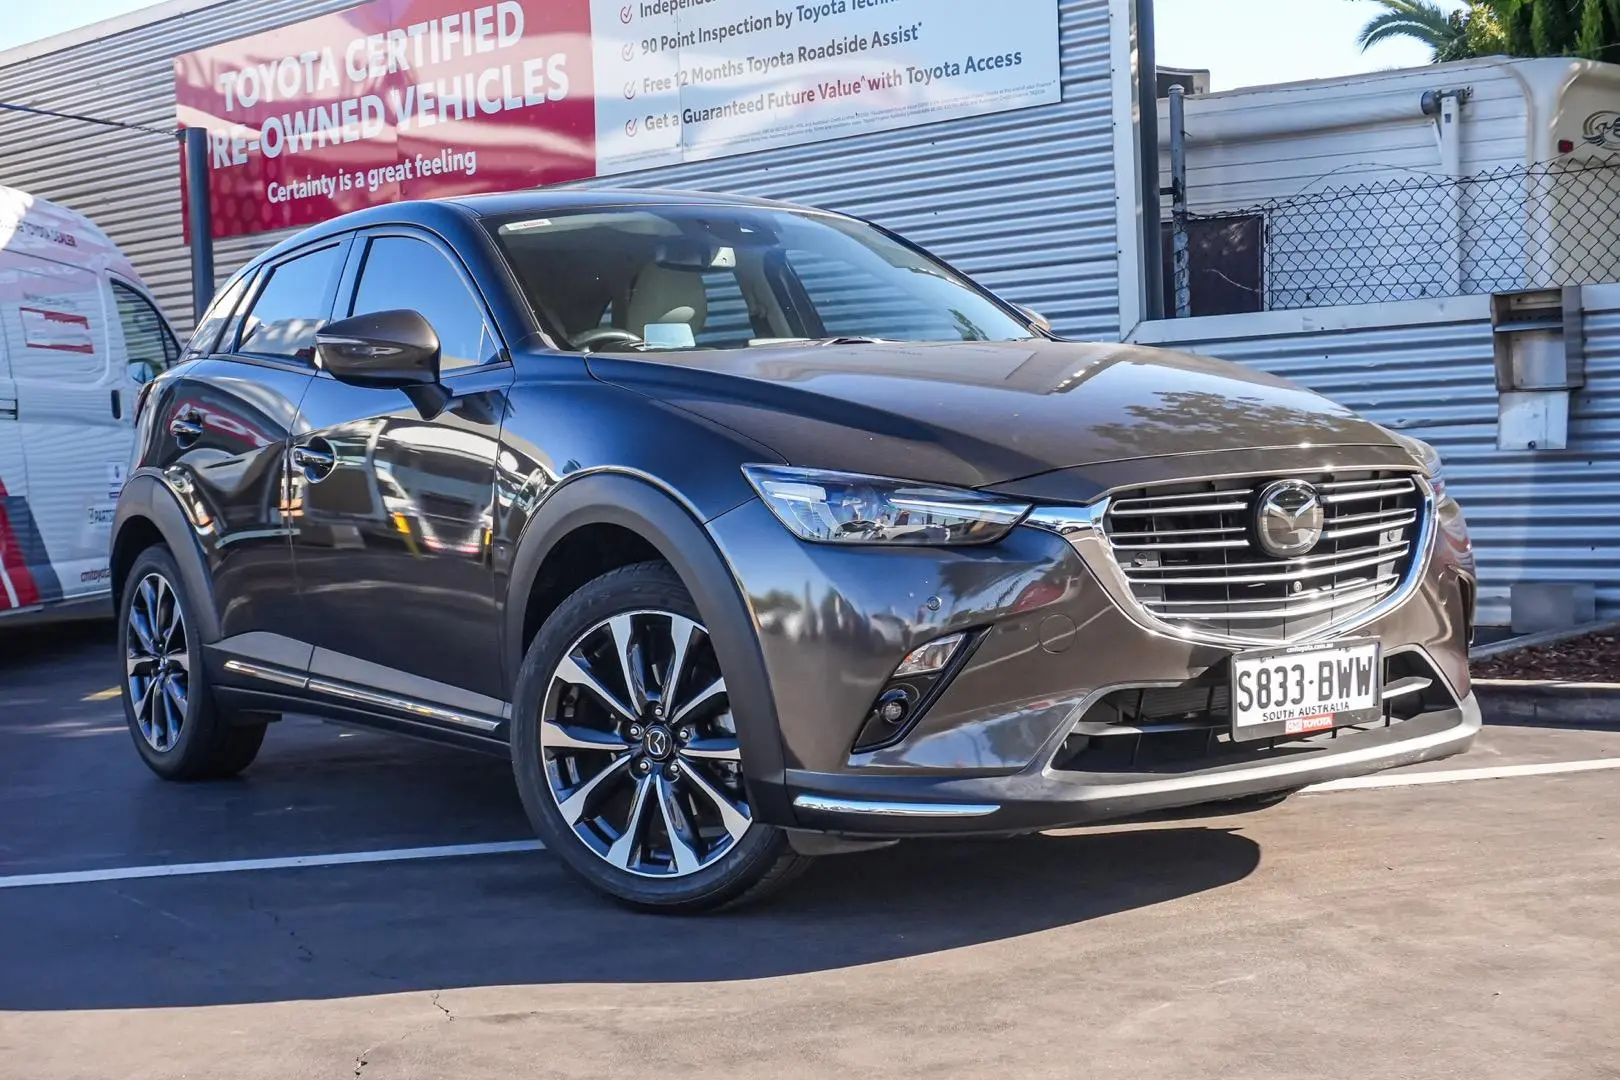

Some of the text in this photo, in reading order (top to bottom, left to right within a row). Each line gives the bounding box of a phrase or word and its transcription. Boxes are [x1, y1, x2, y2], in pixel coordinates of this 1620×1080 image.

[640, 0, 716, 18] Indepen
[641, 0, 899, 56] 90 Point Inspection by Toyota Tec
[219, 0, 525, 112] TOYOTA CERTIFIED
[643, 75, 672, 94] Free
[674, 71, 689, 88] 12
[691, 60, 745, 85] Months
[746, 51, 795, 75] Toyota
[797, 34, 868, 62] Roadside
[208, 53, 570, 170] RE-OWNED VEHICLES
[644, 111, 670, 132] Get
[671, 113, 680, 127] a
[682, 94, 765, 125] Guaranteed
[767, 88, 816, 110] Future
[867, 69, 903, 91] with
[905, 61, 961, 86] Toyota
[963, 50, 1023, 75] Access
[267, 147, 477, 204] Certainty is a great feeling
[1262, 701, 1350, 722] SOUTH AUSTRALIA
